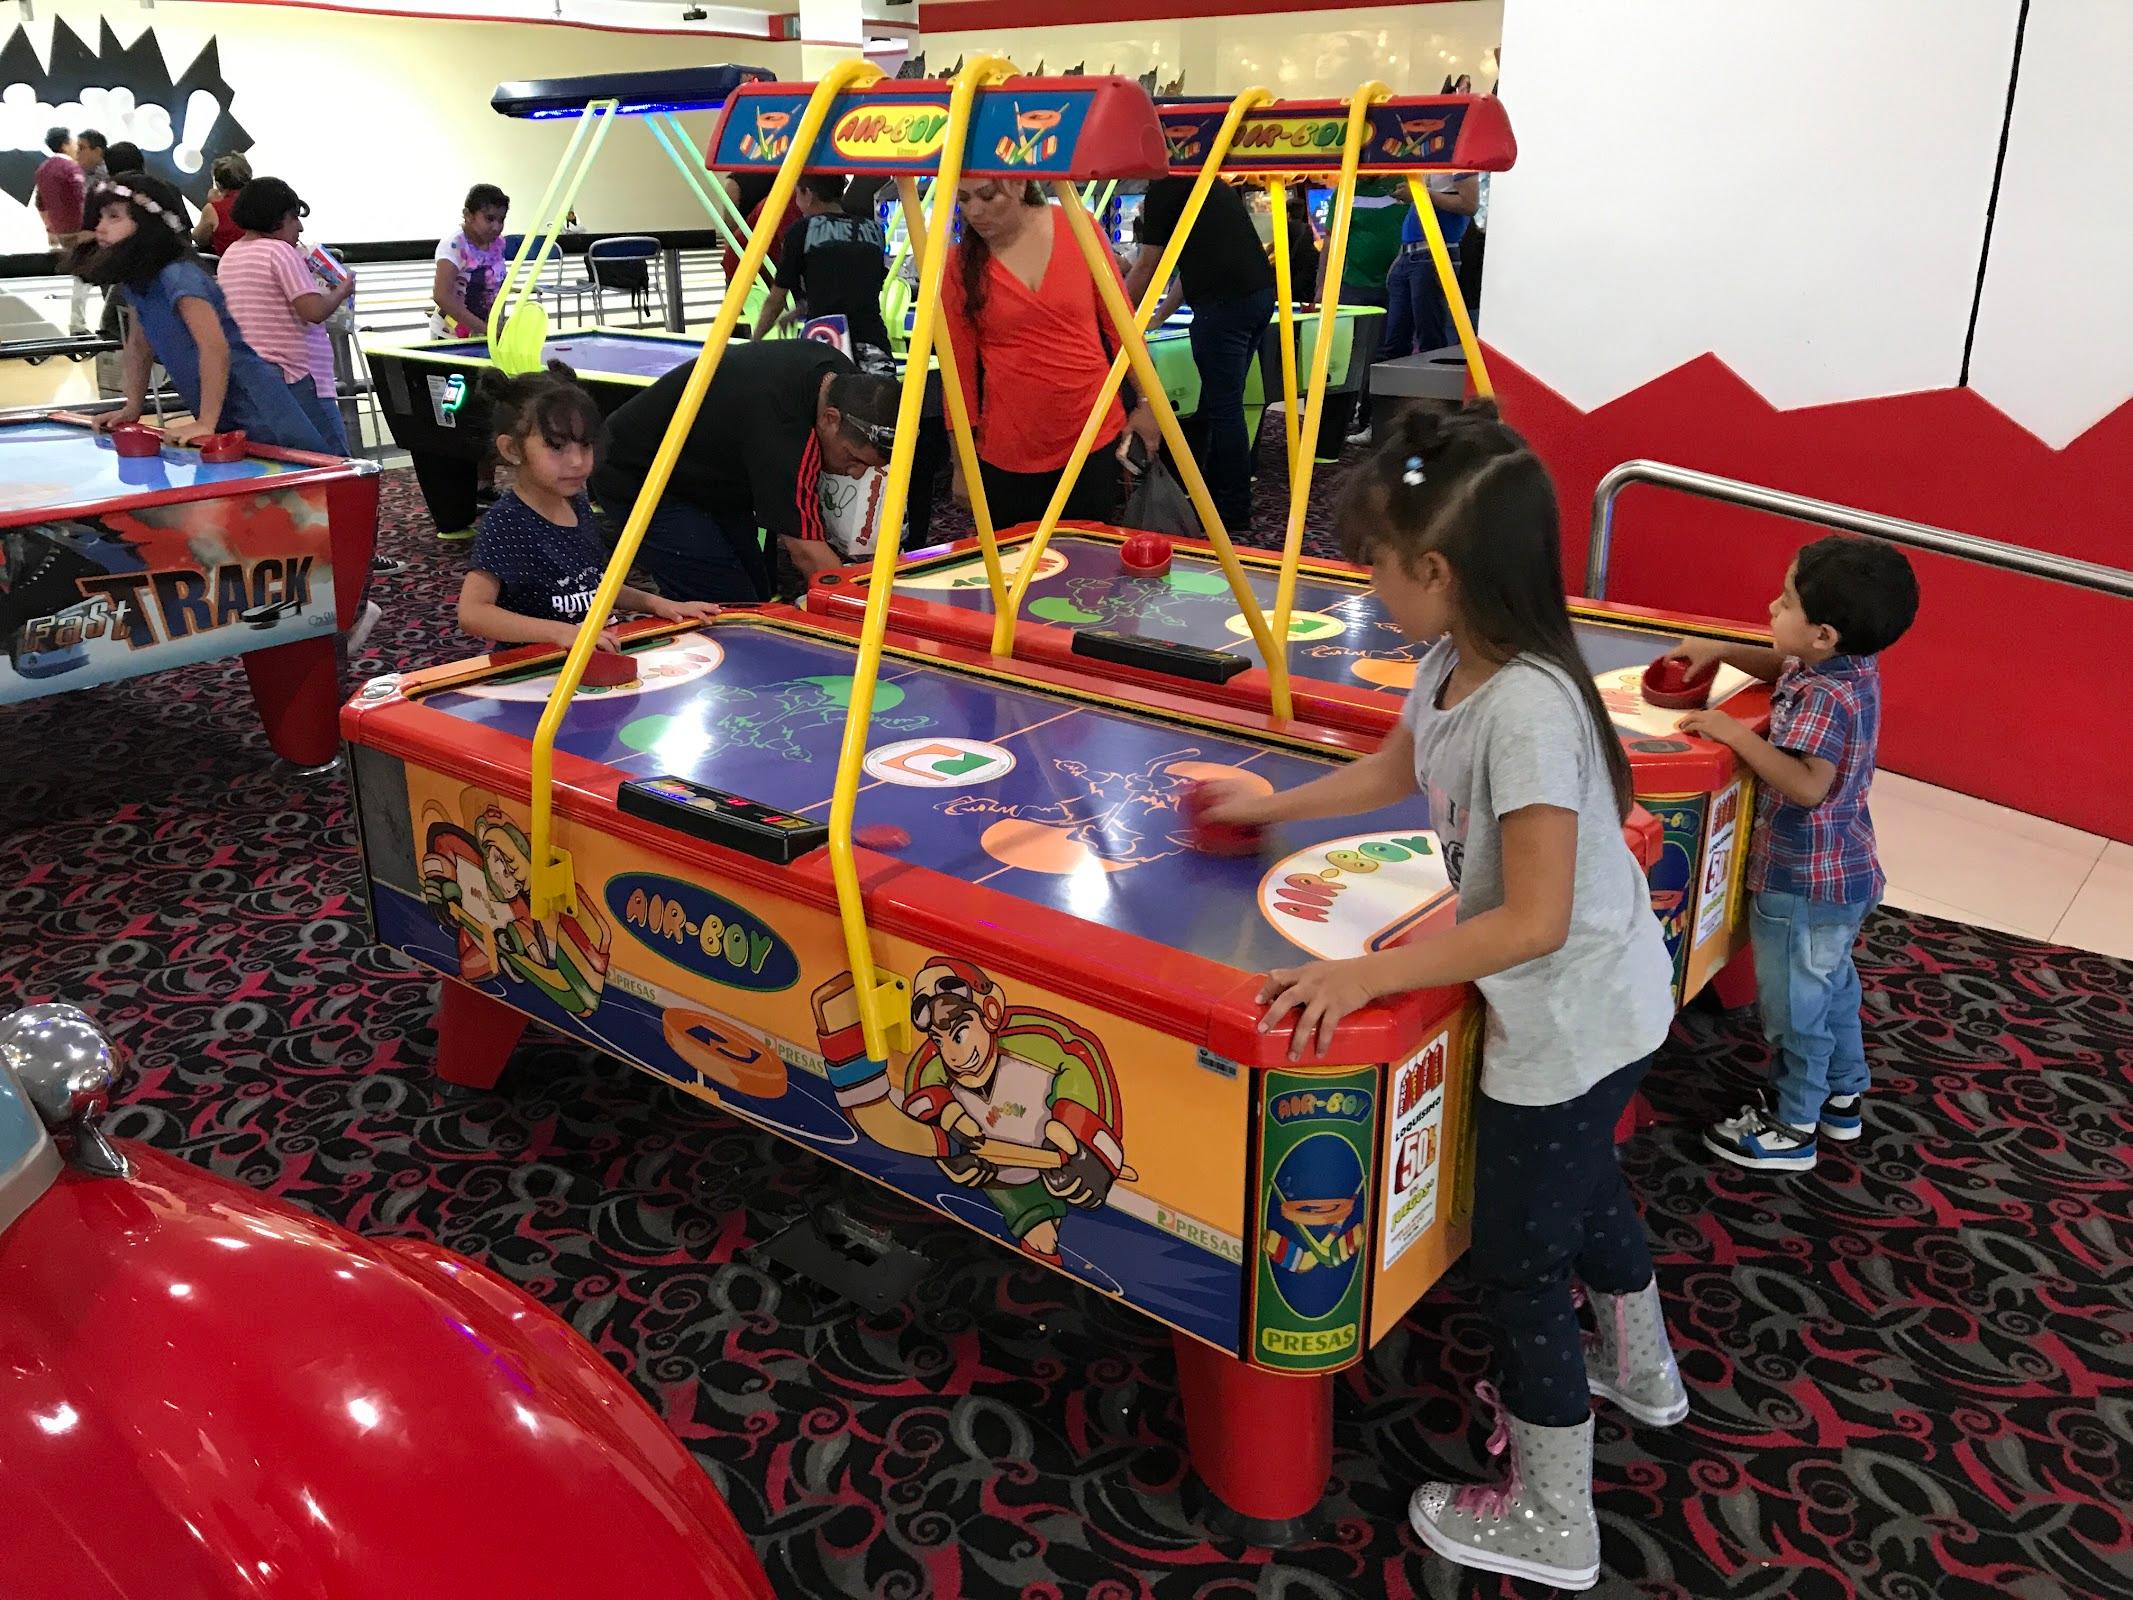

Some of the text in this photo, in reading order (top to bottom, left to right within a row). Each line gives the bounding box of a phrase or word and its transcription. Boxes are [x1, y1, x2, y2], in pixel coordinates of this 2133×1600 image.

[836, 114, 949, 144] AIR-BOY
[75, 556, 314, 651] TRACK
[1273, 836, 1434, 923] AIR-BOY
[626, 887, 773, 975] AIR-BOY
[616, 974, 657, 1001] PRESAS
[778, 1043, 824, 1074] PRESAS
[1176, 1218, 1242, 1259] PRESAS
[1266, 1326, 1354, 1352] PRESAS
